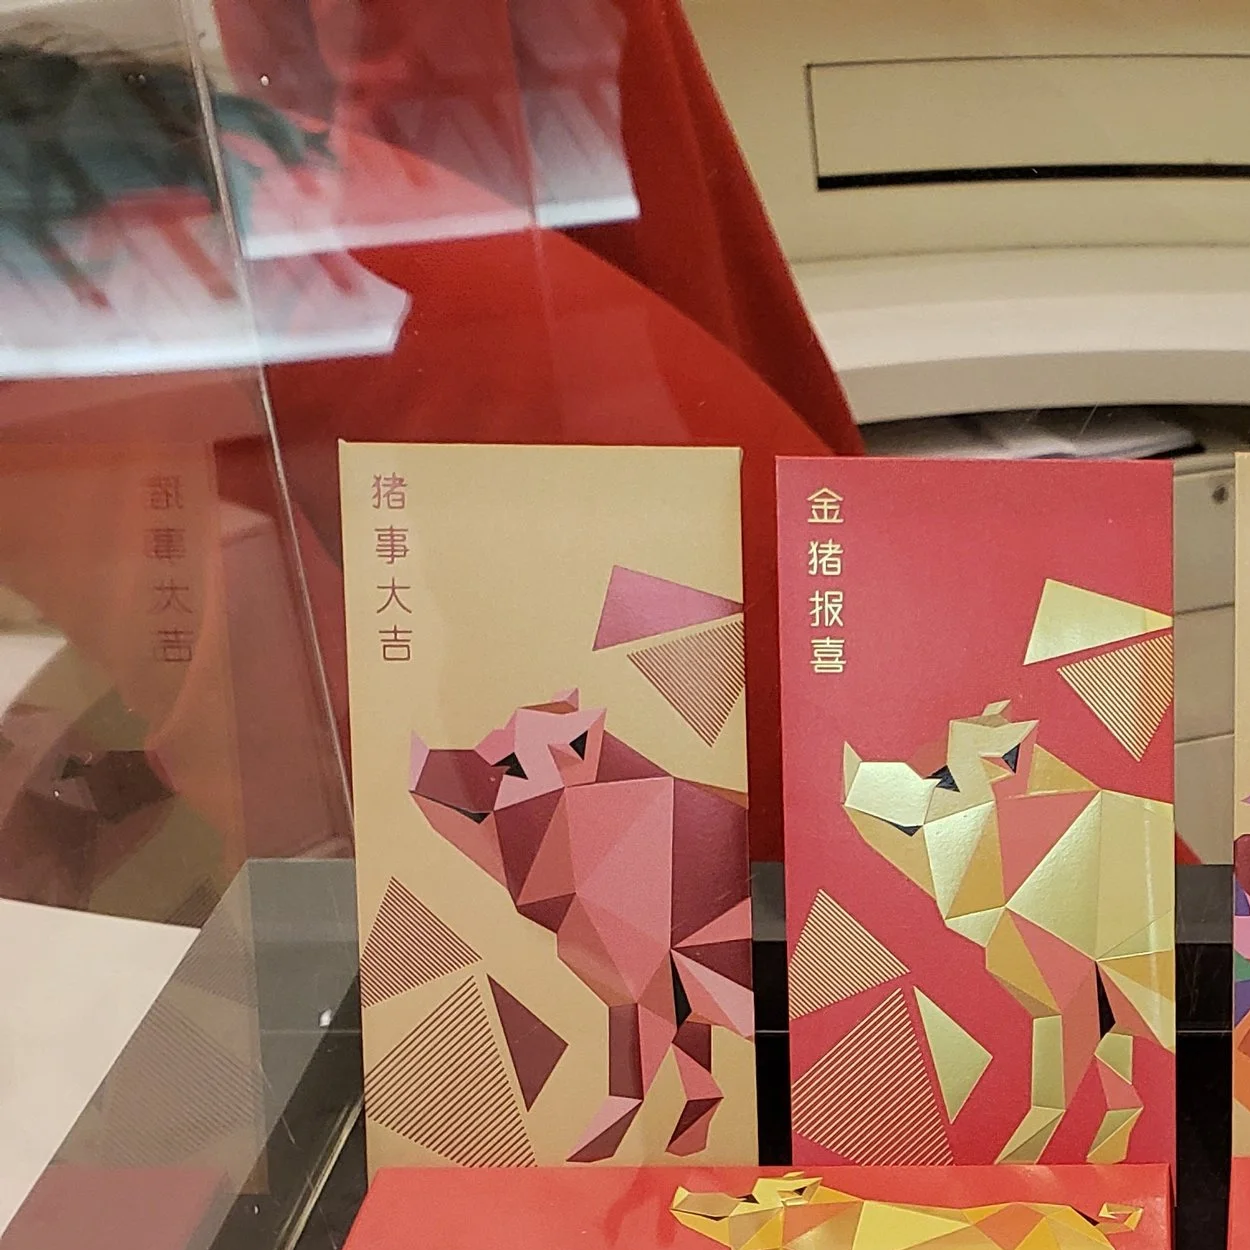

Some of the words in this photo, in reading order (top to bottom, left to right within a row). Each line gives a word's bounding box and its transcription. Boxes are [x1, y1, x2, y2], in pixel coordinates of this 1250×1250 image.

[371, 471, 413, 662] 猪事大吉
[806, 487, 847, 674] 金猪报喜
